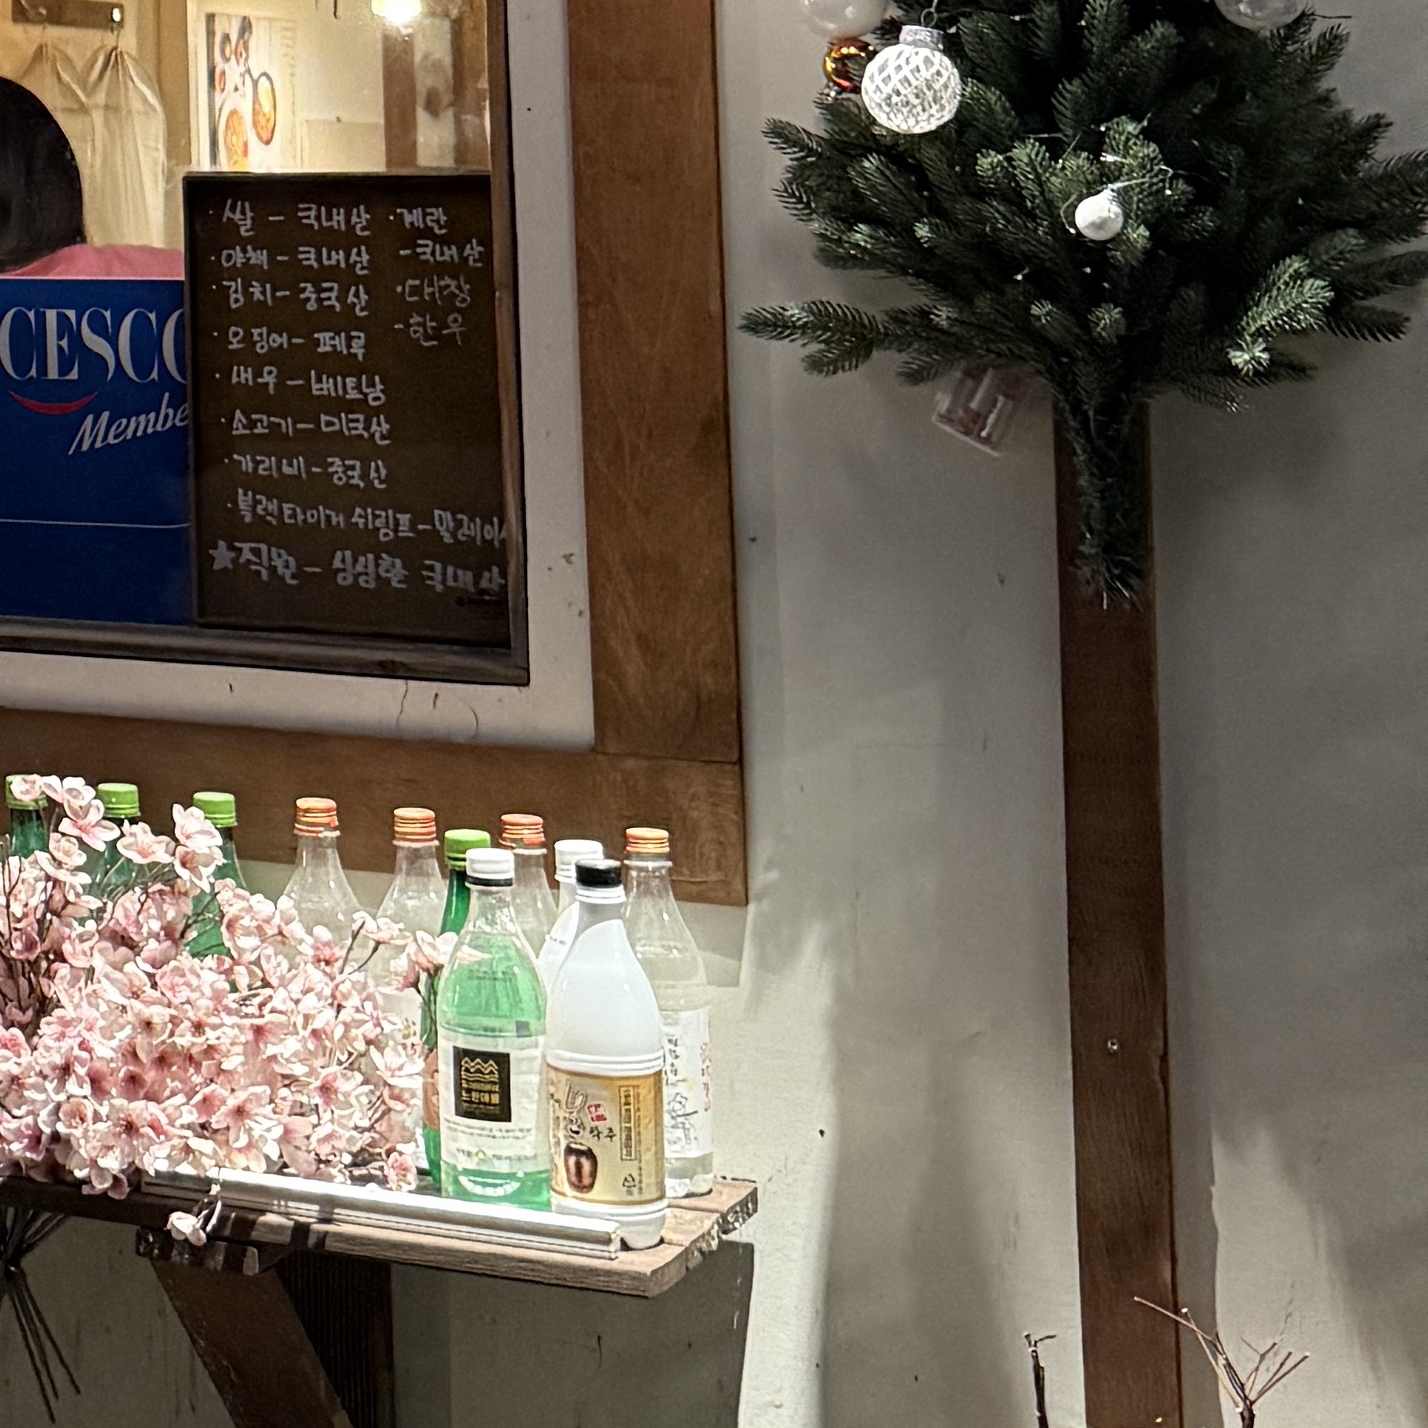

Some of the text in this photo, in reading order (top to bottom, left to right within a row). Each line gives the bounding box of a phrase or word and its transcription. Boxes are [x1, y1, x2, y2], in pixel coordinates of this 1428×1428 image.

[223, 199, 371, 236] 쌀 국내산
[397, 207, 448, 235] 계란
[221, 245, 370, 274] 야채 국내산
[415, 238, 484, 267] 국내산
[223, 278, 369, 316] 김치 중국산
[228, 326, 366, 362] 오징어 페루
[231, 365, 386, 407] 새우 베트남
[232, 409, 391, 445] 소고기 미국산
[233, 454, 388, 489] 가리비 중국산
